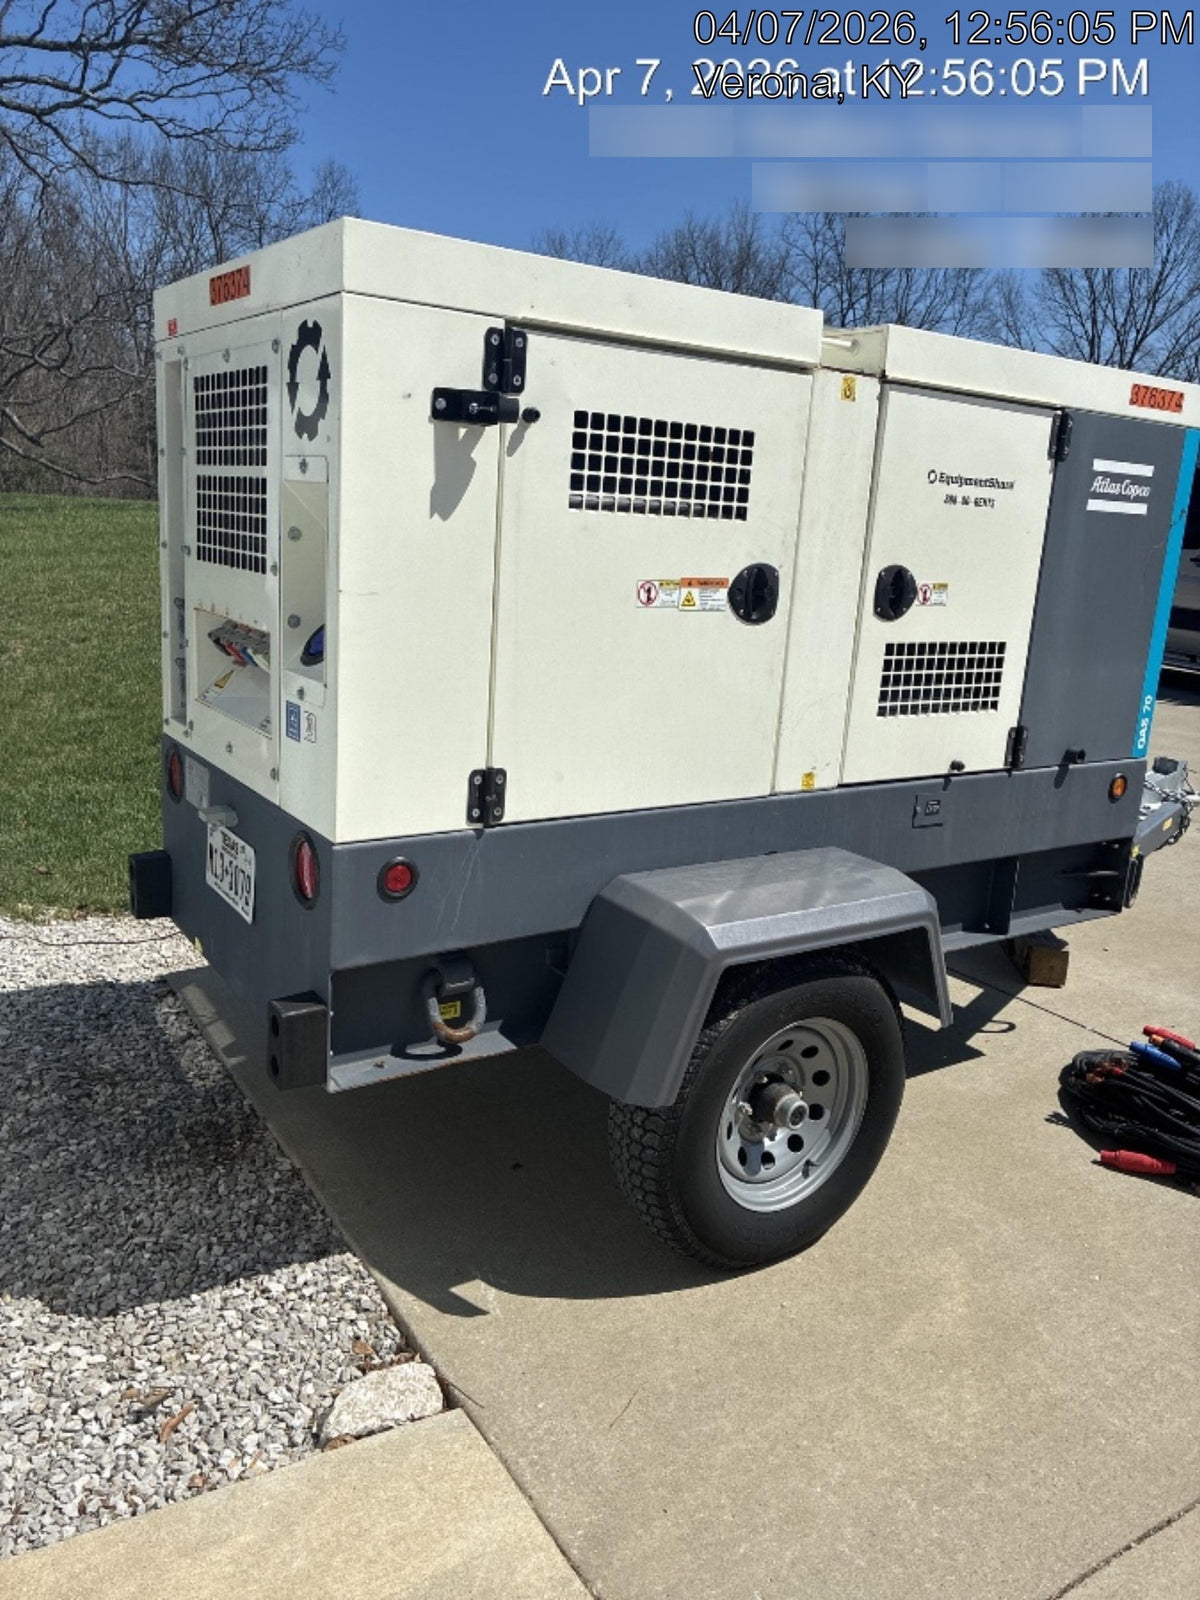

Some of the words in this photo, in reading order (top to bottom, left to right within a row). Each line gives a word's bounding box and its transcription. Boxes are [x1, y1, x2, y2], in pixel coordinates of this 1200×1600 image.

[1129, 383, 1184, 414] 376374
[1090, 476, 1121, 496] Atlas
[1121, 479, 1151, 500] Copco
[1142, 694, 1153, 714] 70
